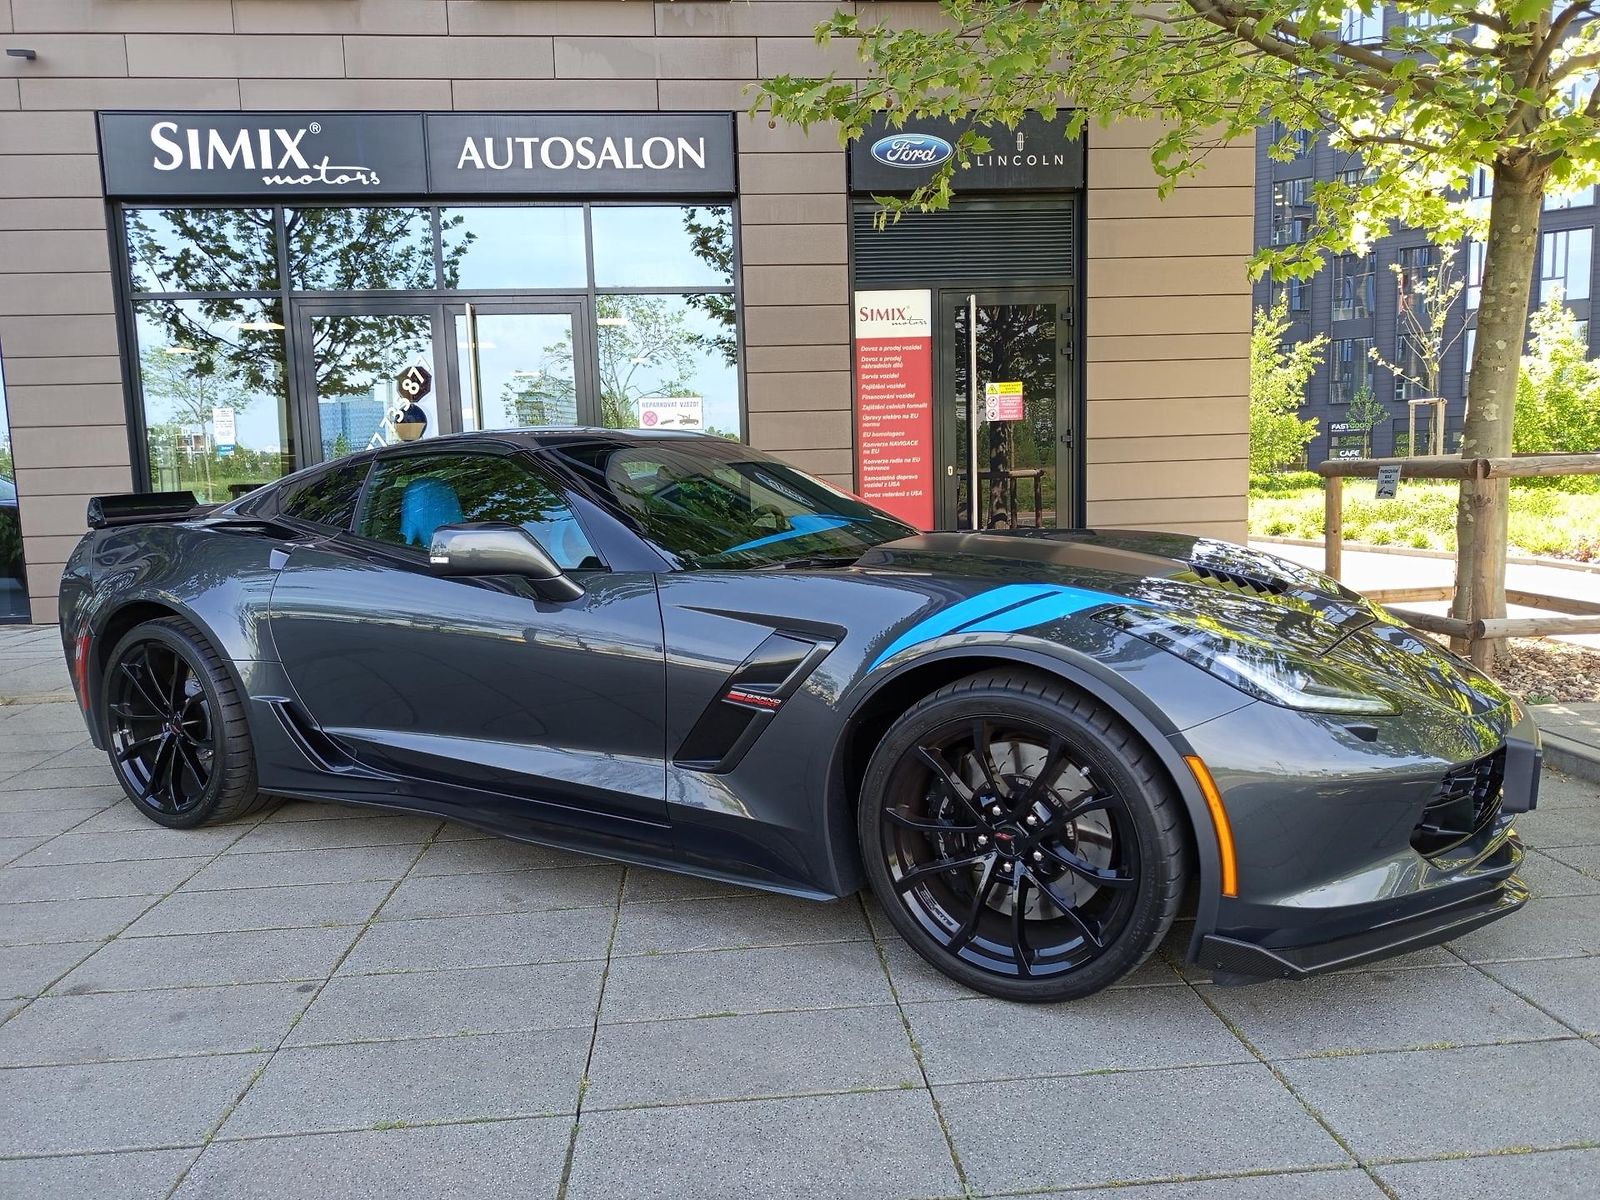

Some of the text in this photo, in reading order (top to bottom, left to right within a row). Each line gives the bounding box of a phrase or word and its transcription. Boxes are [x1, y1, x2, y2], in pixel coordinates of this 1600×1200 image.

[457, 136, 705, 169] AUTOSALON
[886, 139, 937, 162] Ford
[977, 154, 1064, 167] LINCOLN
[262, 156, 381, 185] motors
[883, 345, 902, 353] prodej
